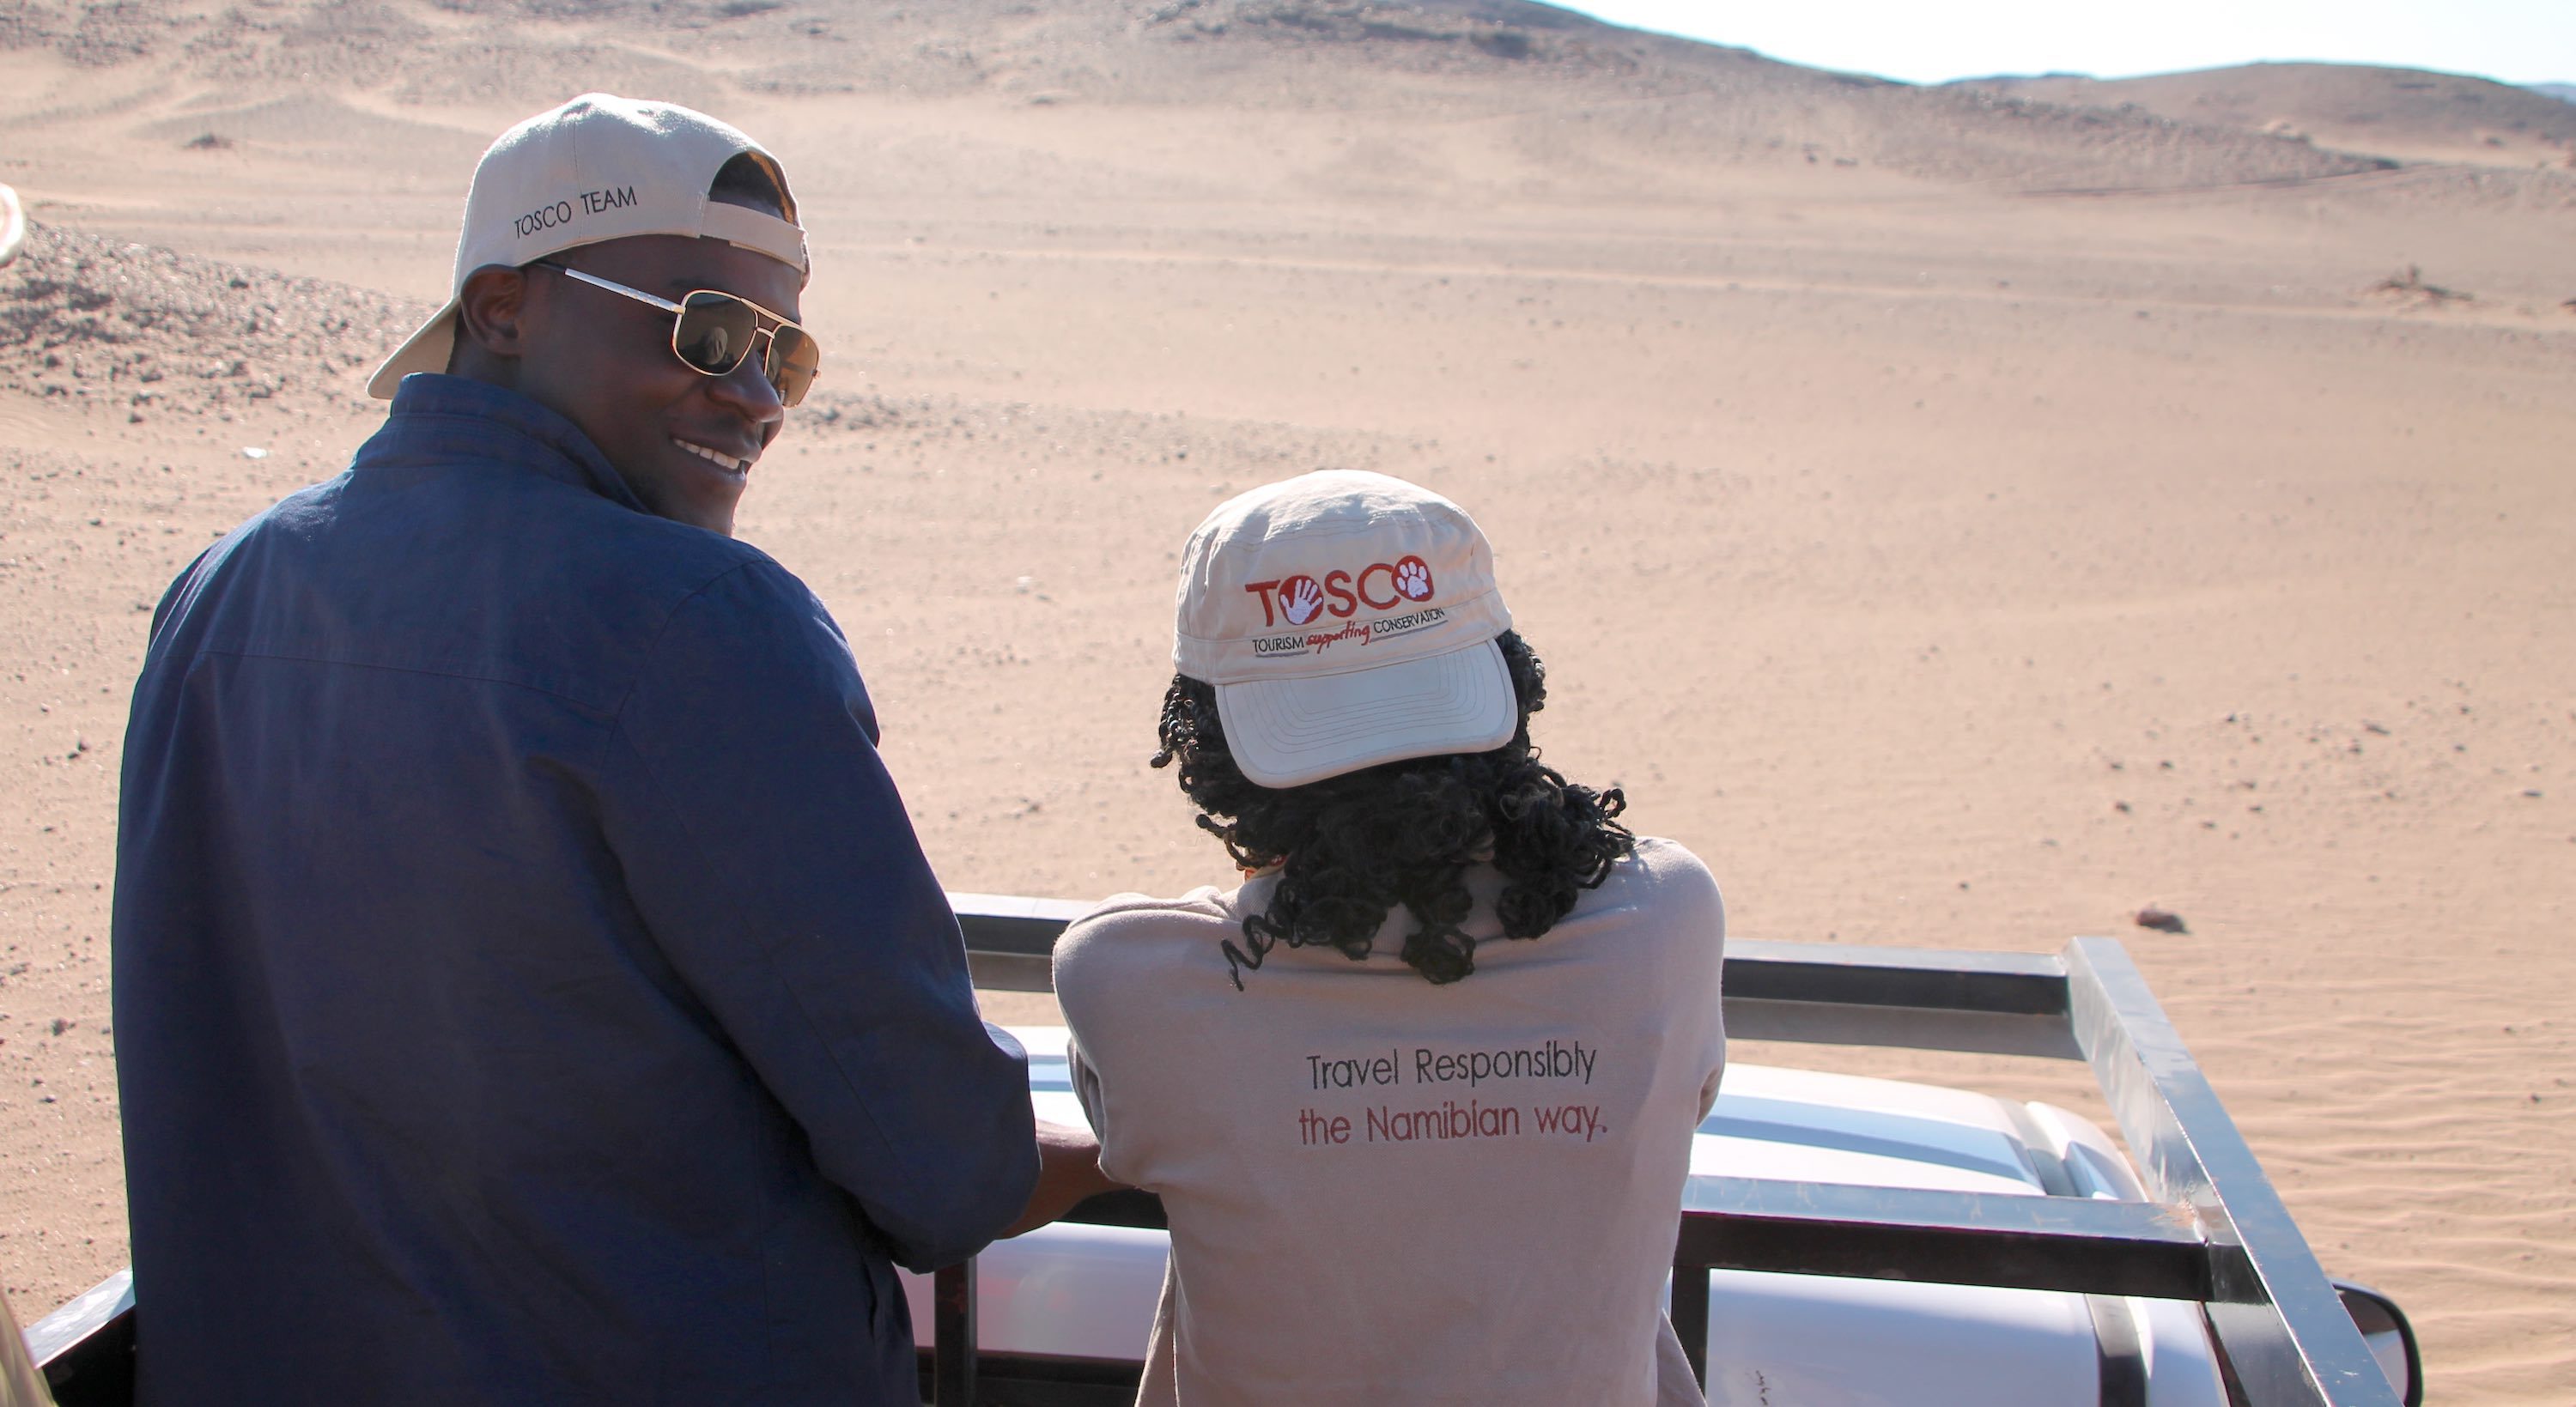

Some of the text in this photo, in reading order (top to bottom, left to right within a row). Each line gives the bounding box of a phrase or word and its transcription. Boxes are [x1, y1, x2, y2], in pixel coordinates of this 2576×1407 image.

[514, 185, 637, 240] TOSCO TEAM
[1245, 555, 1435, 627] TOSCO
[1252, 607, 1445, 654] TOURISM supporting CONSERVATION
[1306, 1040, 1597, 1089] Travel Responsibly
[1298, 1099, 1608, 1145] the Namibian way.
